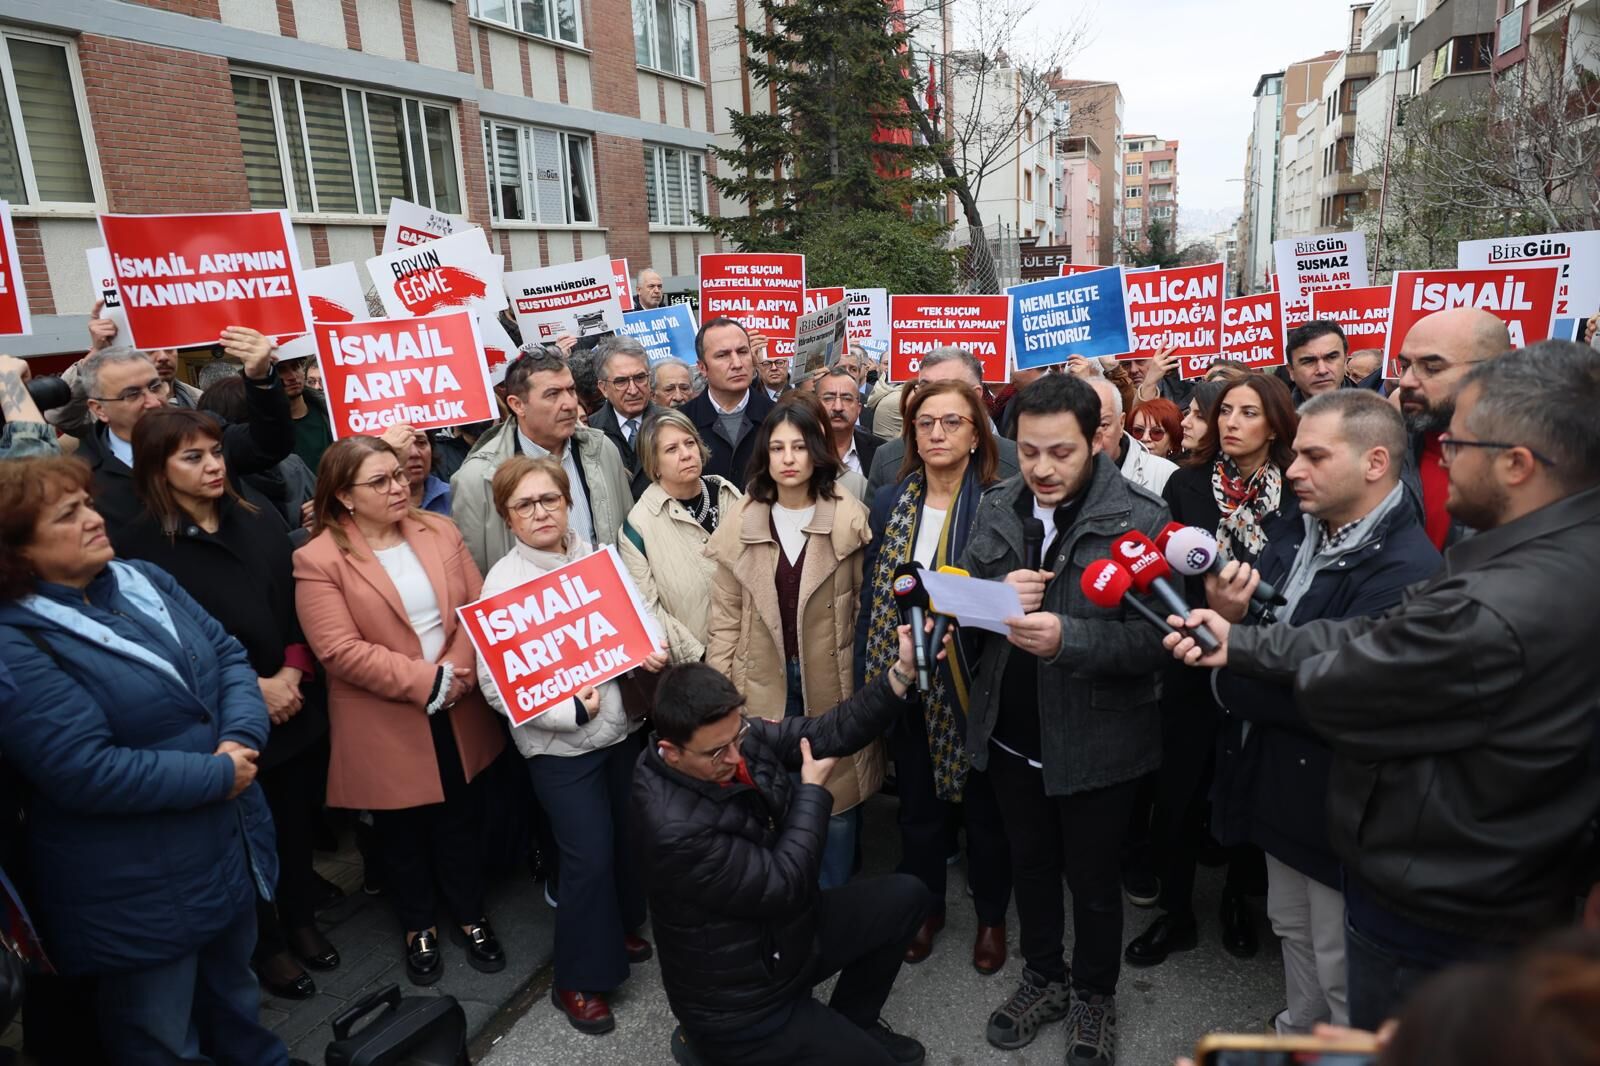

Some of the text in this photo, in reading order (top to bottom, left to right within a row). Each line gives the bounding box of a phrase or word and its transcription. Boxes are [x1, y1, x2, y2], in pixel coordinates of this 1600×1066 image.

[114, 250, 286, 278] İSMAİL ARI'NIN
[391, 249, 441, 281] BOYUN
[750, 265, 783, 275] SUÇUM
[1297, 256, 1349, 271] SUSMAZ
[123, 275, 292, 308] YANINDAYIZ!
[399, 269, 452, 306] EĞME
[523, 277, 597, 297] BASIN HÜRDÜR
[702, 277, 762, 288] GAZETECİLİK
[1128, 275, 1217, 305] ALİCAN
[1298, 272, 1350, 284] İSMAİL ARI
[518, 288, 610, 311] SUSTURULAMAZ
[708, 297, 754, 312] İSMAİL
[757, 299, 798, 313] ARI'YA
[1019, 285, 1100, 314] MEMLEKETE
[1412, 275, 1533, 311] İSMAİL
[651, 315, 680, 331] ARI'YA
[893, 317, 955, 329] GAZETECİLİK
[946, 307, 980, 317] SUÇUM
[1022, 306, 1092, 332] ÖZGÜRLÜK
[1316, 308, 1361, 321] İSMAİL
[328, 323, 454, 366] İSMAİL
[1024, 325, 1092, 352] İSTİYORUZ
[343, 365, 462, 404] ARI'YA
[348, 400, 468, 433] ÖZGÜRLÜK
[1130, 551, 1159, 573] anka
[1093, 562, 1118, 592] NOW
[474, 573, 602, 646] İSMAİL
[502, 610, 619, 684] ARI'YA
[515, 644, 632, 713] ÖZGÜRLÜK
